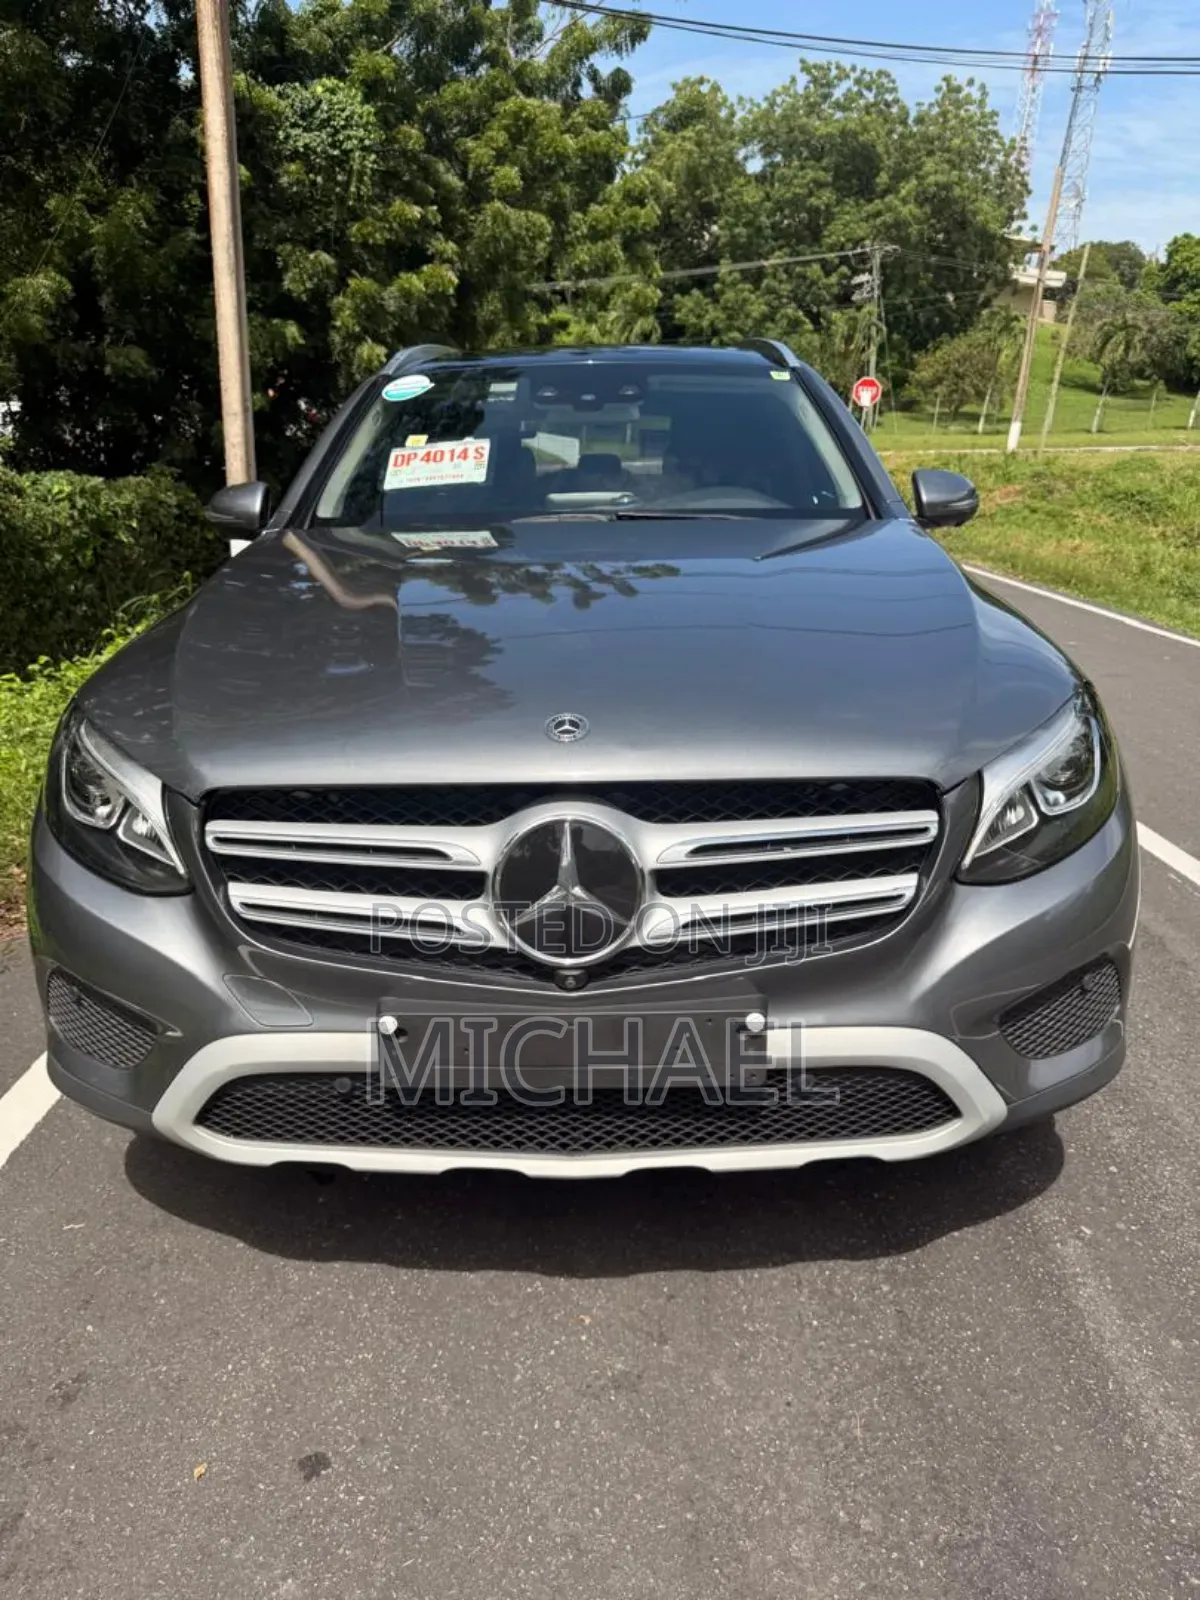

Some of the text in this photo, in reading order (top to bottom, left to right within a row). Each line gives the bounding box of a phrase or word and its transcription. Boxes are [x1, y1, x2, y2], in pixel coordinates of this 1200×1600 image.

[393, 445, 486, 468] DP 4014 S
